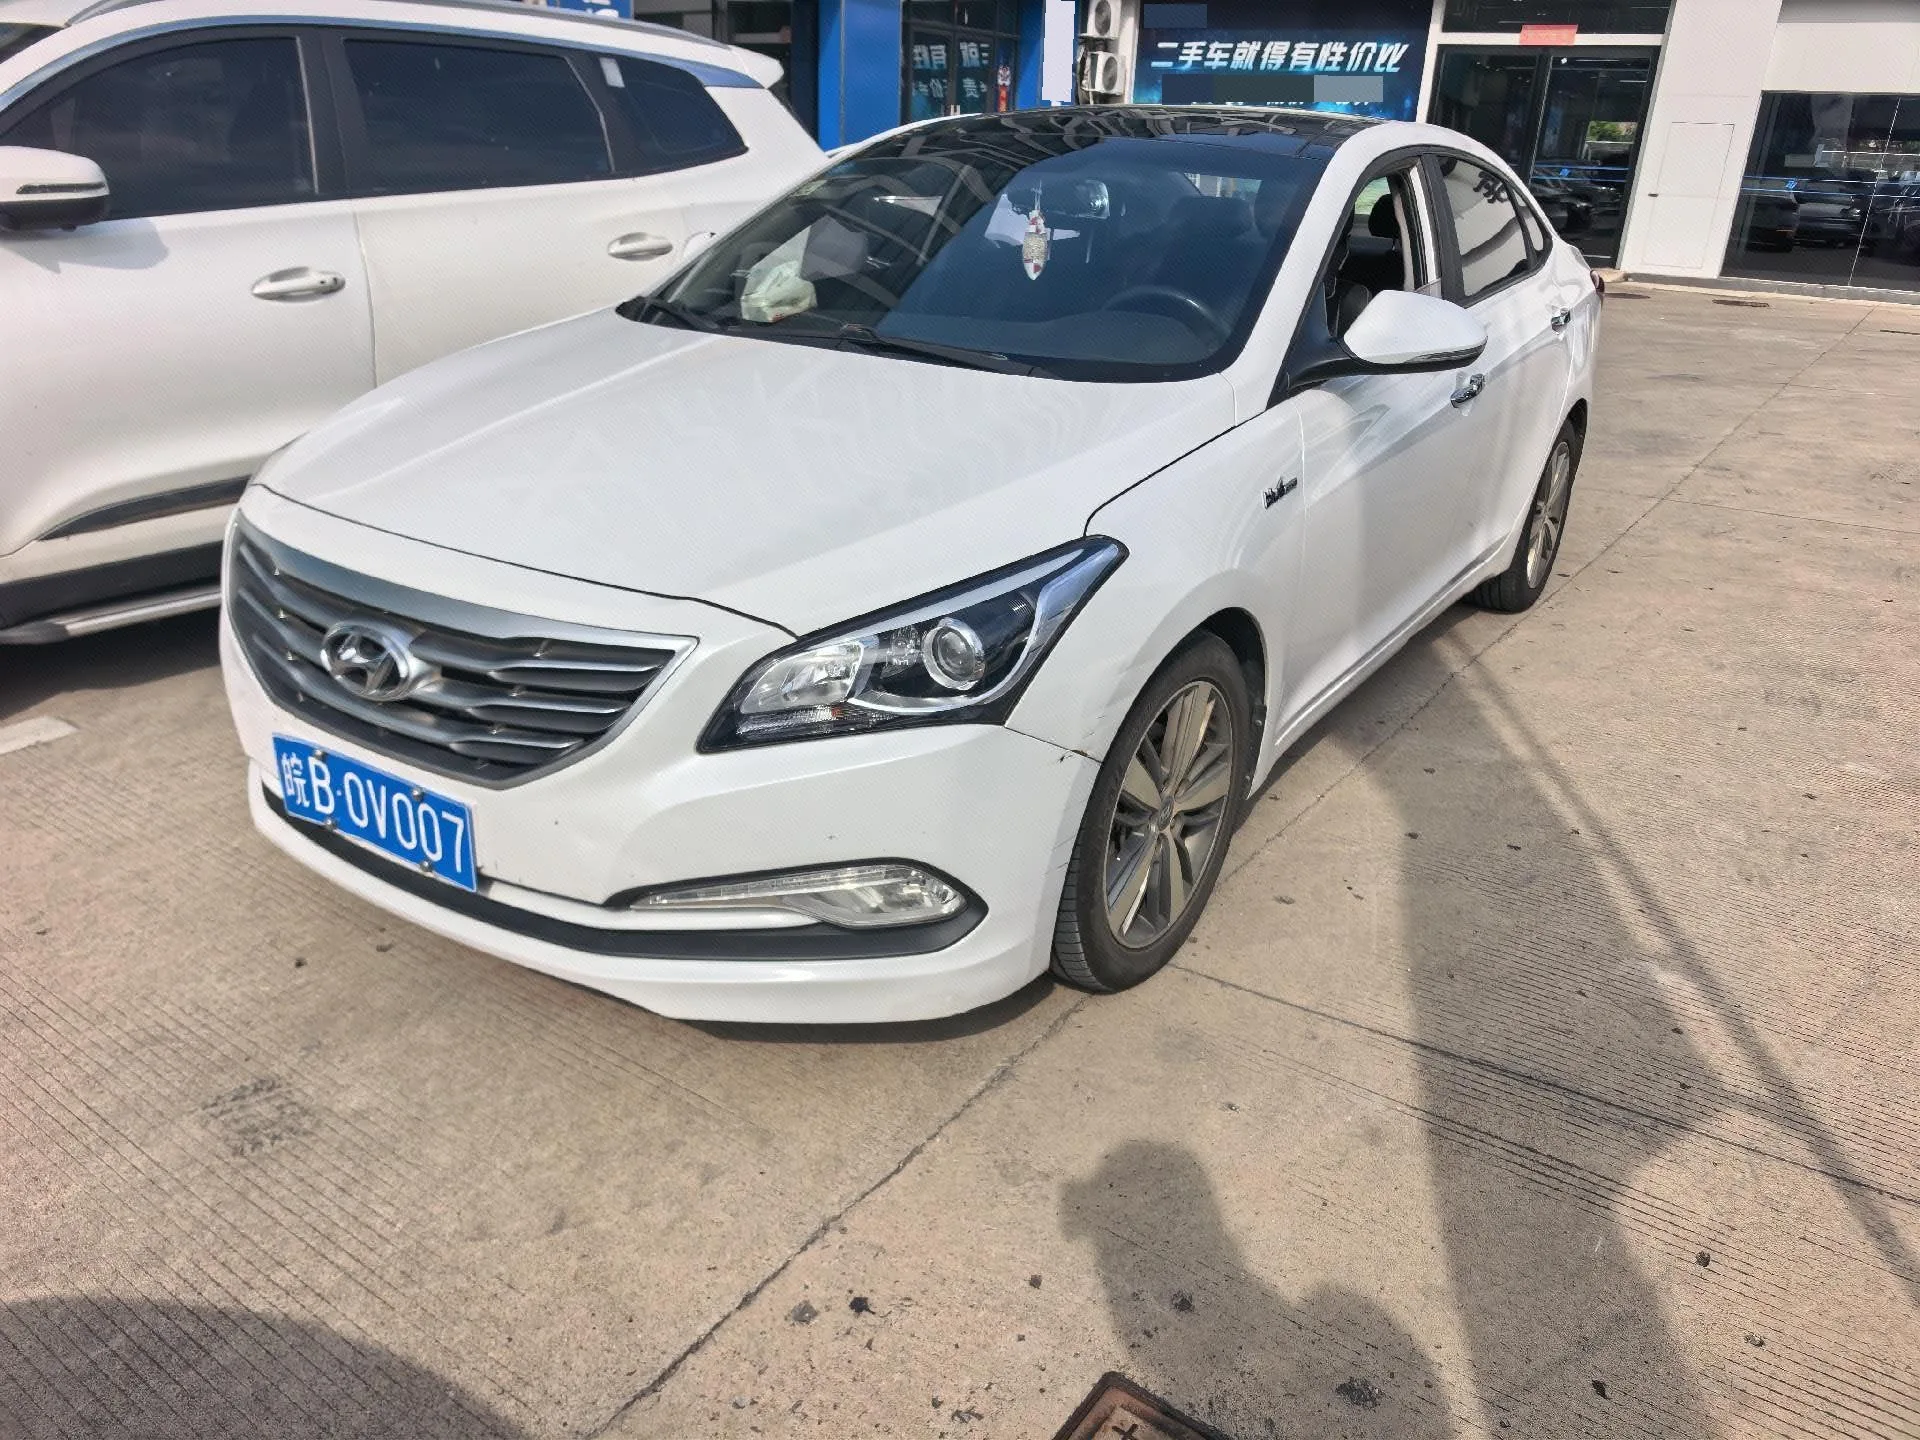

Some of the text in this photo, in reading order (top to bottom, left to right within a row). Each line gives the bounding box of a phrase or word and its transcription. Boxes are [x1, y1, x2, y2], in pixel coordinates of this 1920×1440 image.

[1150, 41, 1408, 73] 二手车就得有性价比
